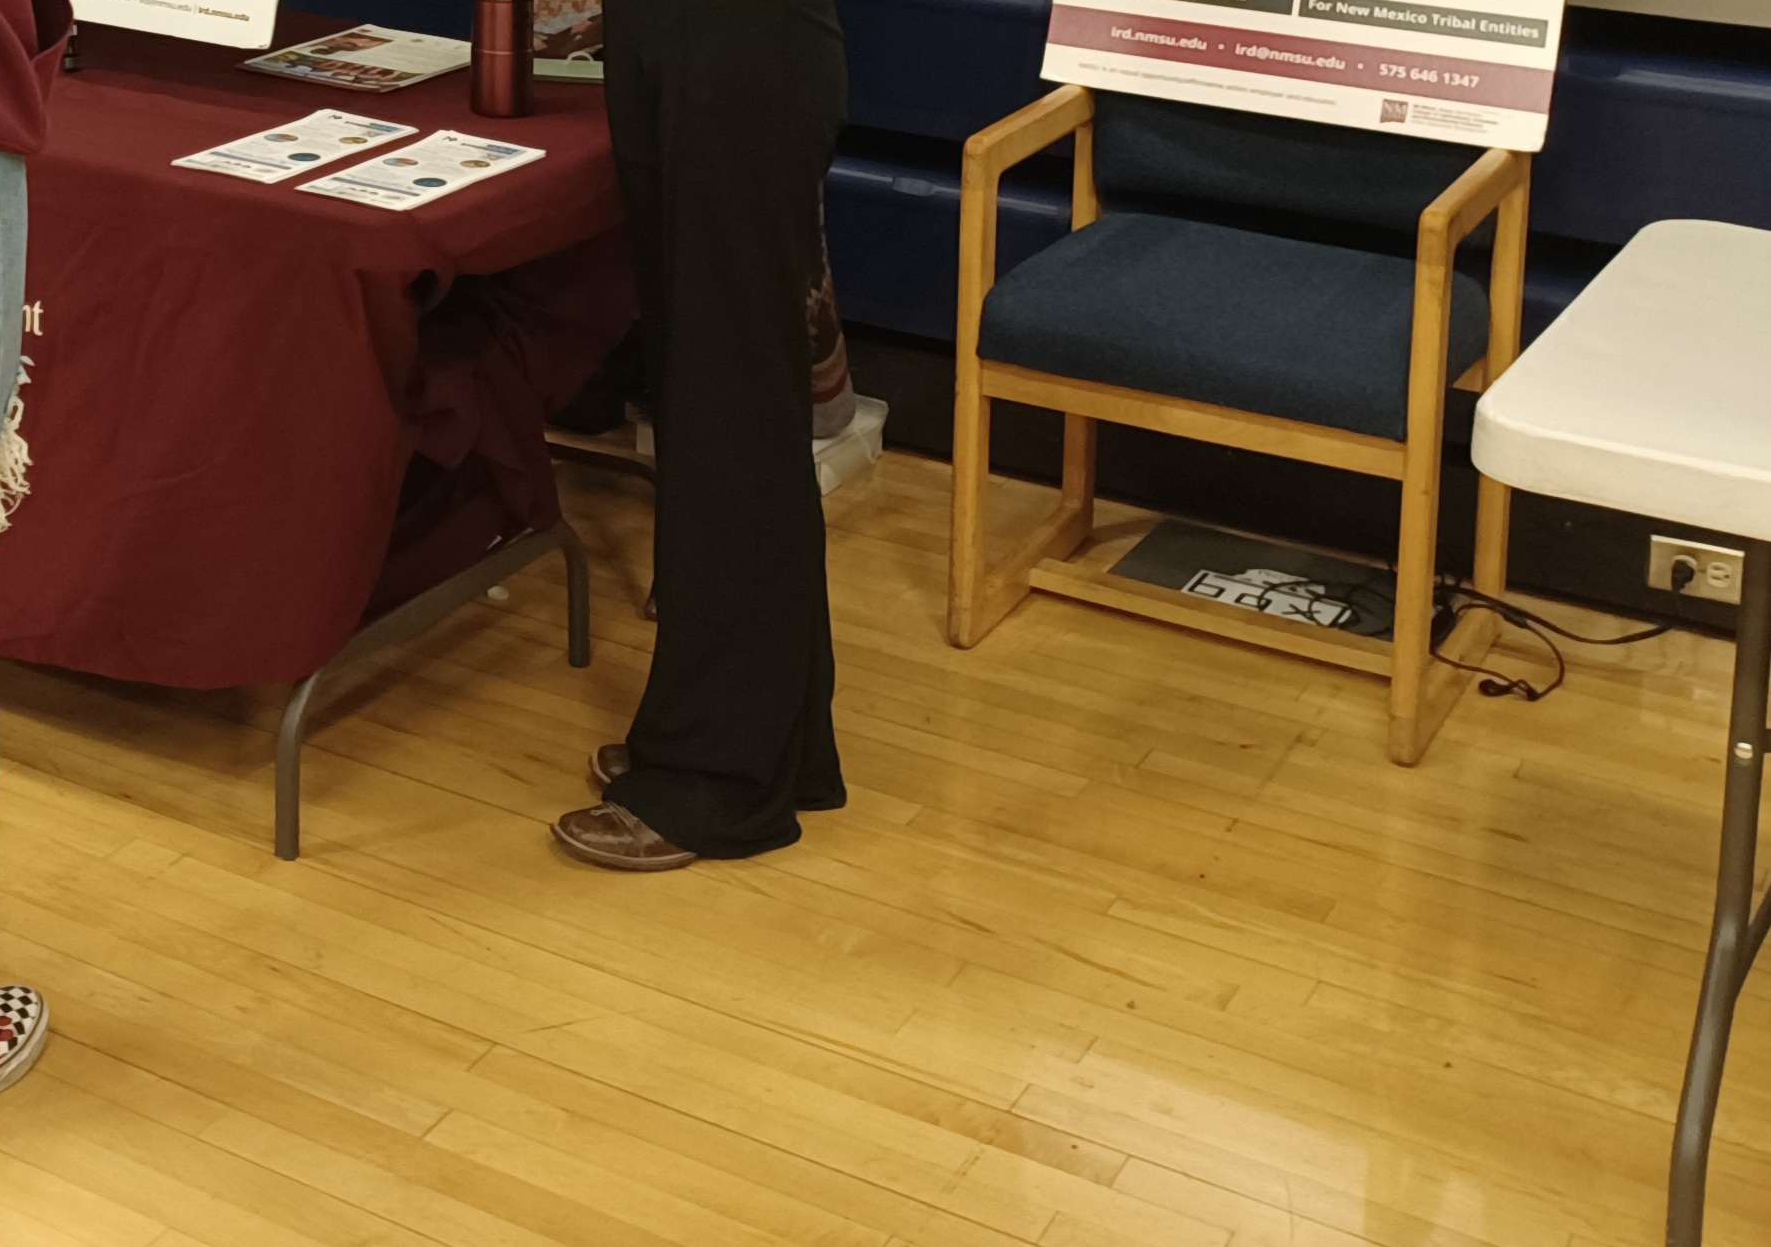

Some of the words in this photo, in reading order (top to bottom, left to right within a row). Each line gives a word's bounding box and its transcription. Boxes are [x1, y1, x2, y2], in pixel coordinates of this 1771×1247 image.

[1336, 1, 1370, 17] New
[1373, 6, 1428, 25] Mexico
[1431, 13, 1476, 31] Tribal
[1479, 19, 1540, 39] Entities
[1110, 25, 1208, 51] ird.nmsu.edu
[1235, 43, 1346, 71] ird@nmsu.edu
[1379, 63, 1407, 79] 575
[1410, 68, 1438, 83] 646
[1442, 71, 1480, 88] 1347
